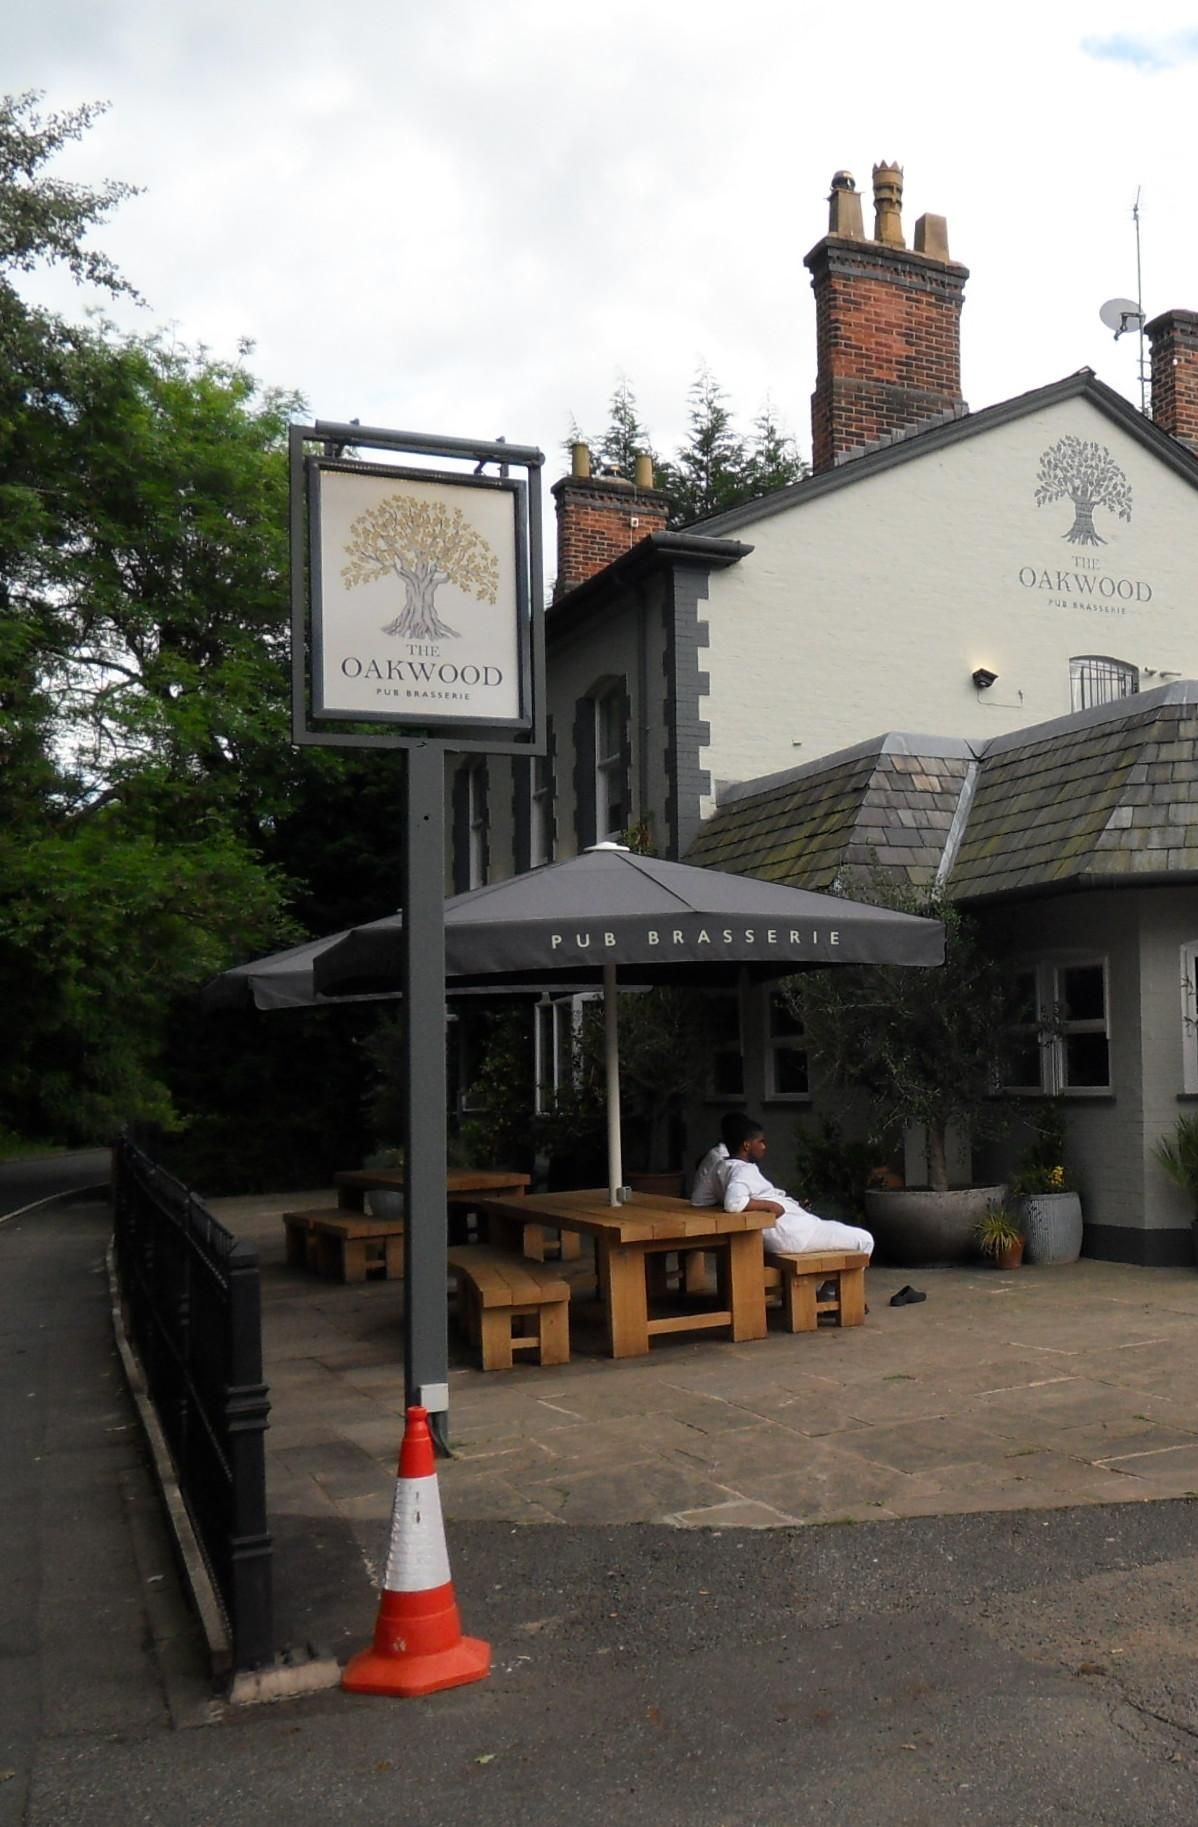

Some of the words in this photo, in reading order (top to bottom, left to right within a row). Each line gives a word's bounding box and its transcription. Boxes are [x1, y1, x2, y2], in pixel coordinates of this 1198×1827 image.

[1072, 556, 1100, 570] THE
[1019, 566, 1152, 602] OAKWOOD
[1048, 599, 1067, 608] PUB
[1073, 602, 1126, 614] BRASSERIE
[406, 643, 440, 657] THE
[341, 657, 503, 687] OAKWOOD
[376, 688, 399, 697] PUB
[406, 690, 471, 700] BRASSERIE
[551, 932, 616, 949] PUB
[648, 929, 840, 946] BRASSERIE
